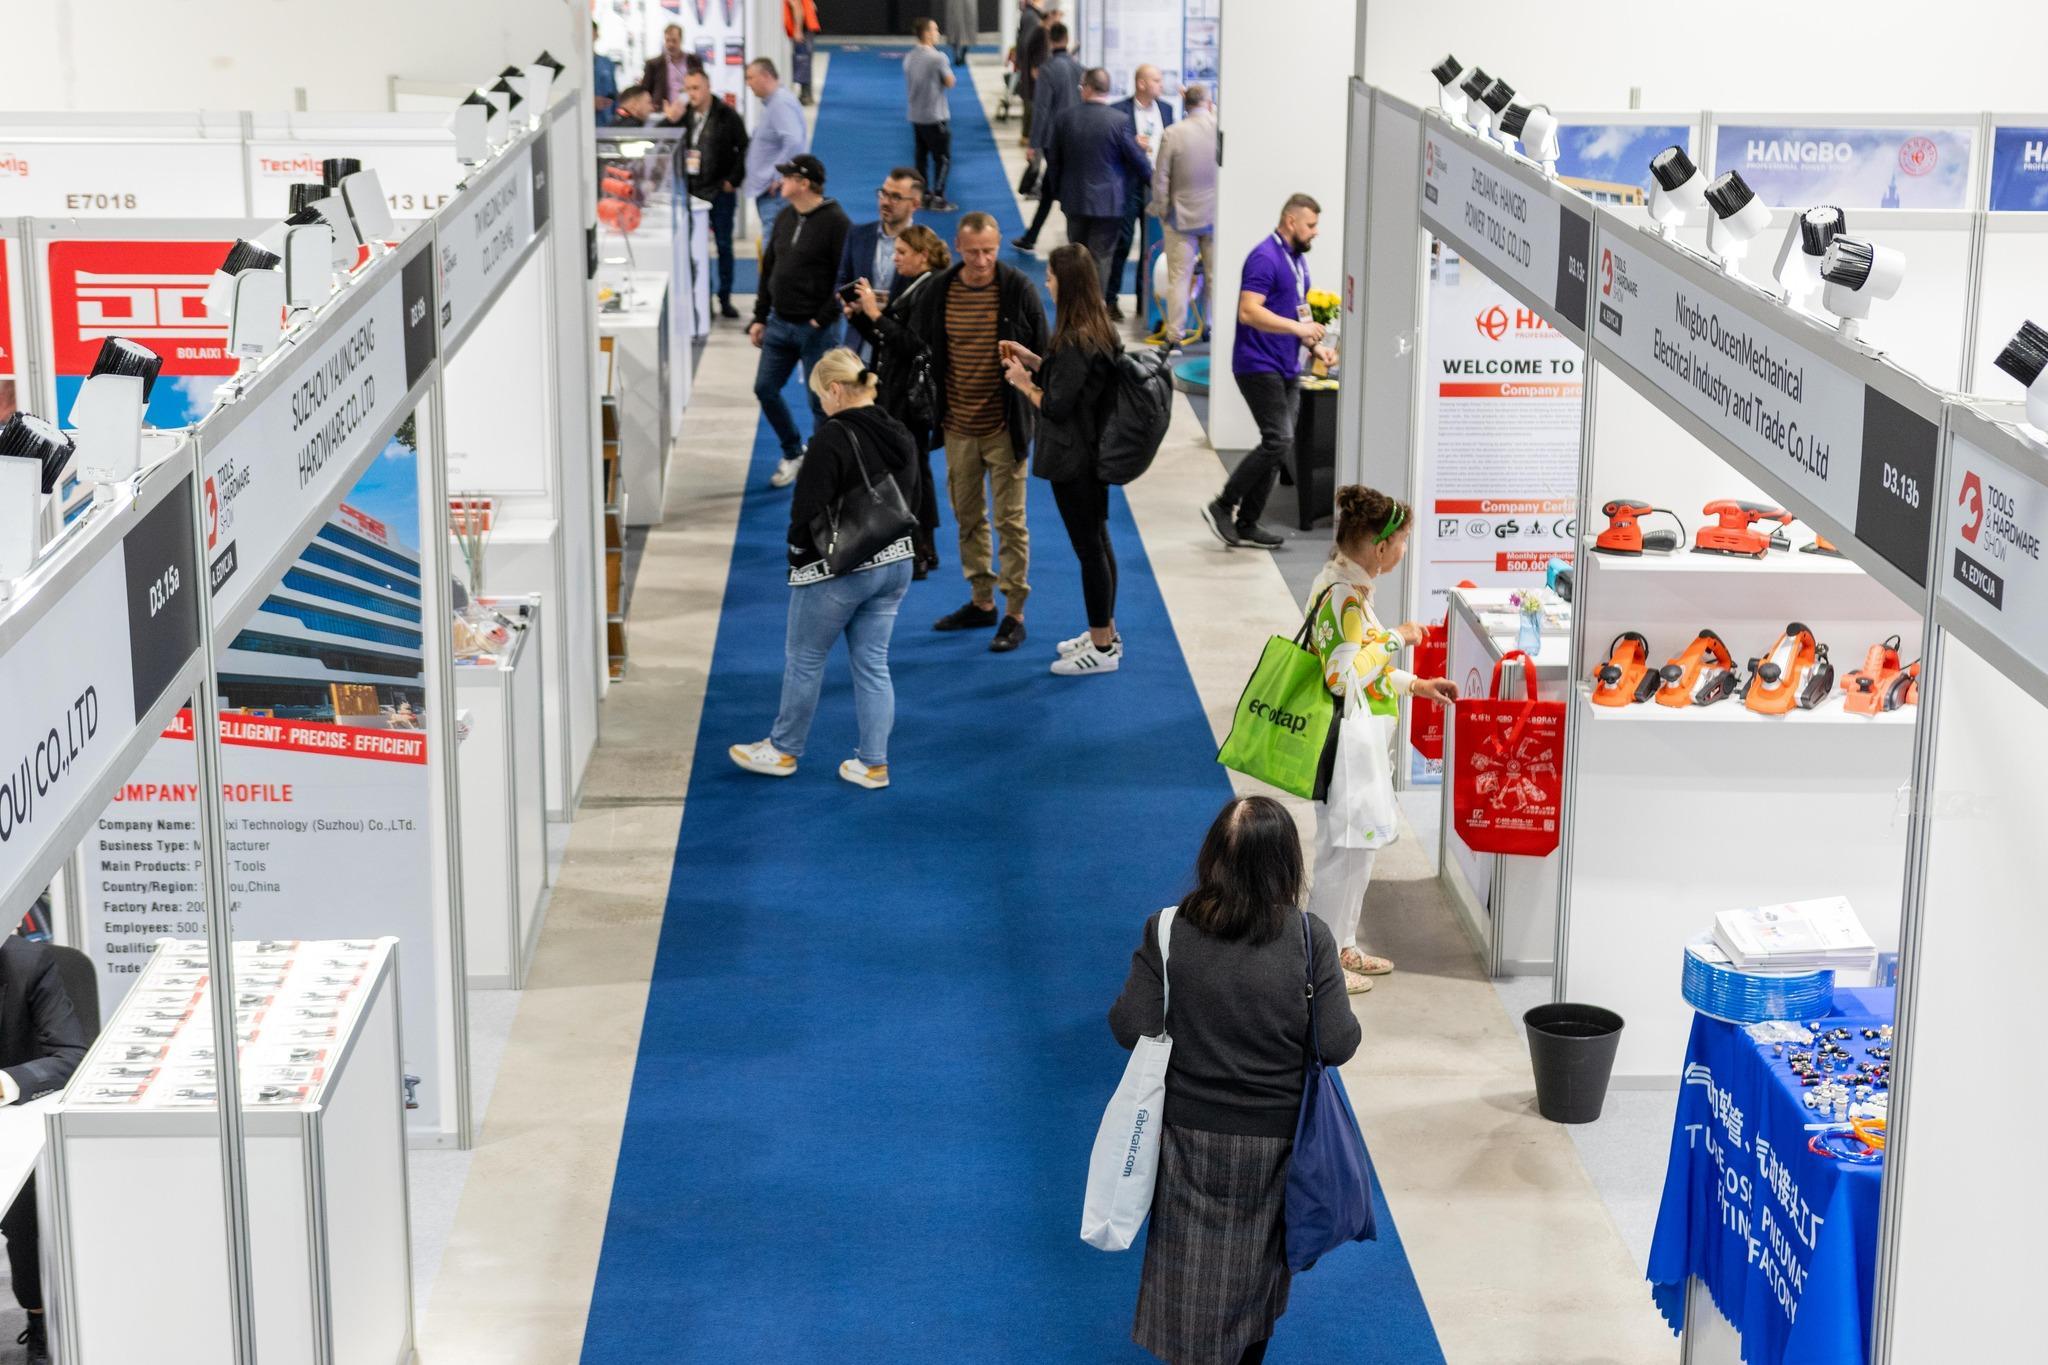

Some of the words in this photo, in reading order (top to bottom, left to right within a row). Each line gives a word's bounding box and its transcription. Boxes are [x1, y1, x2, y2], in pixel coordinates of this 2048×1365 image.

[1746, 140, 1852, 163] HANGBO
[66, 194, 136, 209] E7018
[1487, 215, 1506, 251] TOOLS
[1675, 292, 1708, 341] Ningbo
[1443, 360, 1542, 374] WELCOME
[1550, 360, 1574, 374] TO
[293, 370, 328, 432] SUZHOU
[1501, 384, 1559, 399] Company
[1653, 328, 1692, 382] Electrical
[1693, 354, 1732, 418] Industry
[1733, 392, 1753, 427] and
[1755, 396, 1785, 450] Trade
[298, 405, 346, 490] HARDWARE
[217, 457, 235, 488] TOOLS
[1883, 462, 1920, 509] D3.13b
[1481, 501, 1539, 514] Company
[1988, 485, 2015, 519] TOOLS
[1984, 530, 2007, 562] SHOW
[1993, 514, 2041, 561] HARDWARE
[150, 564, 180, 617] D3.15a
[1961, 561, 1968, 580] 4.
[1969, 564, 1996, 598] EDYCJA
[1249, 699, 1306, 734] ecotap
[219, 721, 286, 743] ELLIGENT-
[354, 733, 422, 757] EFFICIENT
[113, 784, 198, 802] MPANY
[222, 784, 293, 802] ROFILE
[99, 819, 152, 832] Company
[157, 819, 196, 831] Name:
[242, 819, 308, 833] Technology
[312, 819, 364, 833] (Suzhou)
[99, 839, 153, 852] Business
[156, 839, 189, 853] Type:
[101, 860, 131, 872] Main
[134, 860, 191, 872] Products:
[234, 860, 266, 872] Tools
[102, 880, 198, 894] Country/Region:
[104, 901, 147, 915] Factory
[151, 901, 183, 913] Area:
[105, 921, 173, 935] Employees:
[177, 921, 199, 933] 500
[107, 962, 141, 974] Trade
[1122, 1109, 1148, 1177] fabricair.com
[1748, 1236, 1797, 1325] FACTORY
